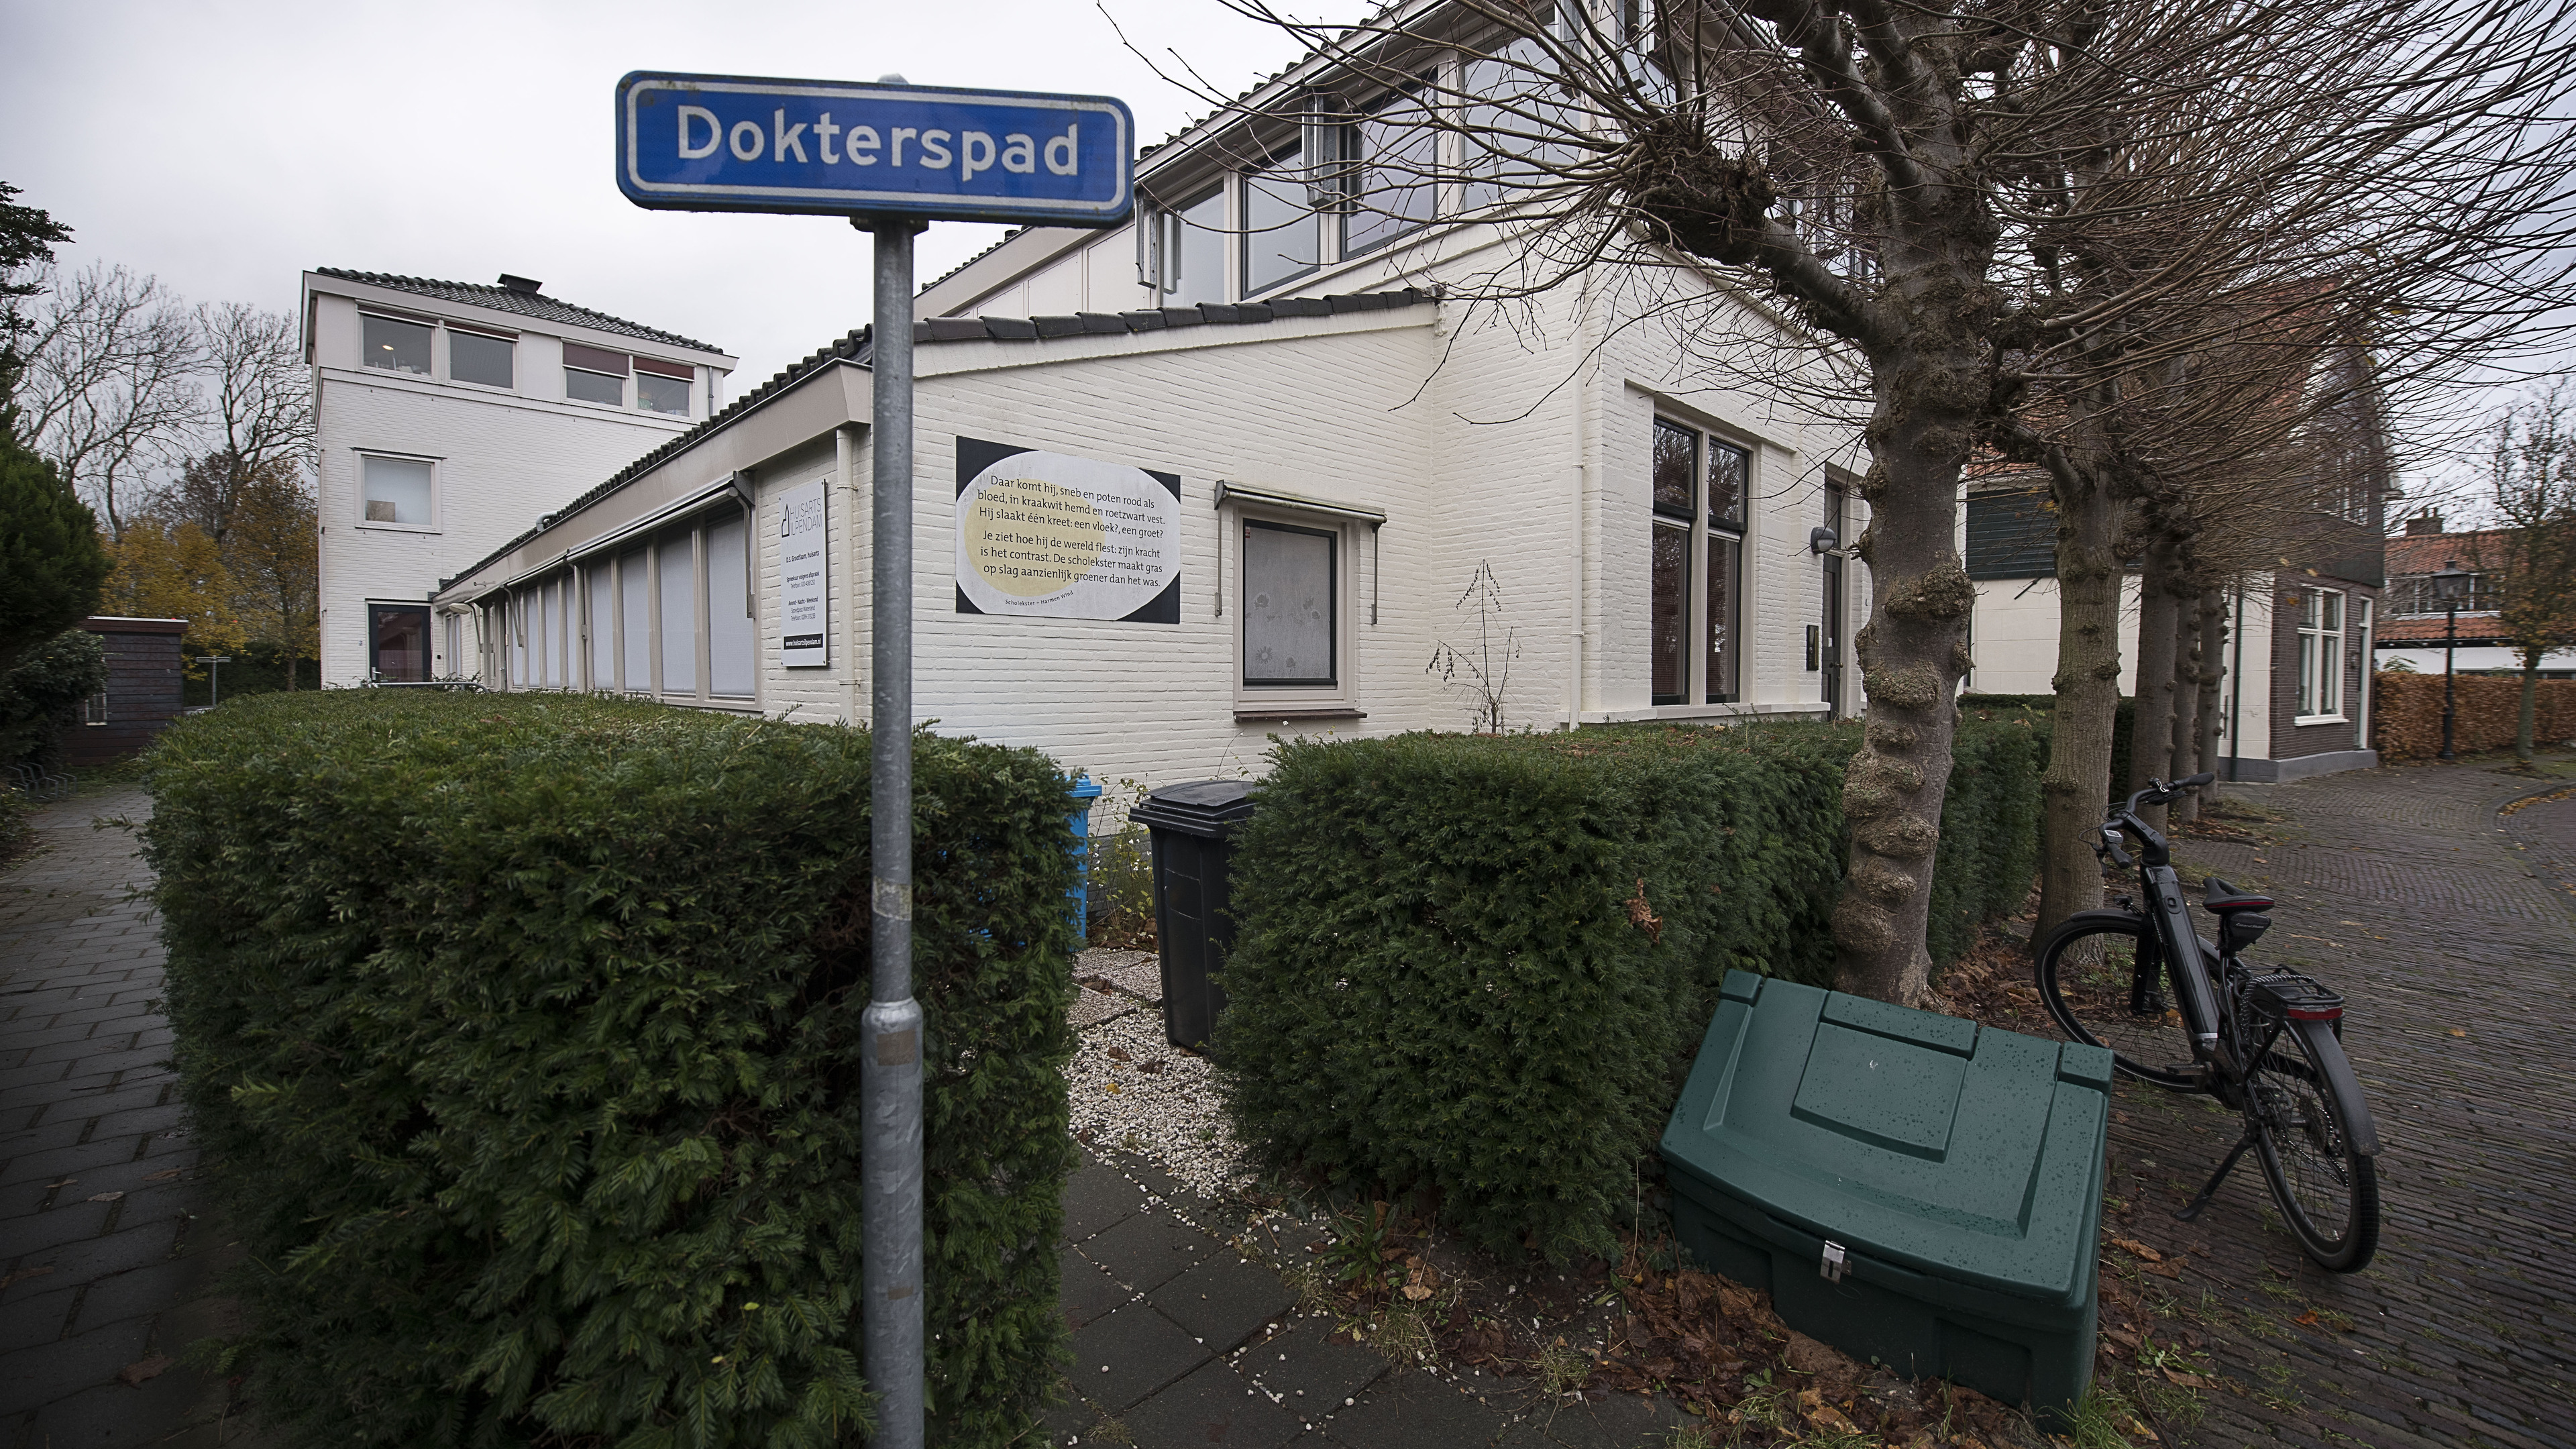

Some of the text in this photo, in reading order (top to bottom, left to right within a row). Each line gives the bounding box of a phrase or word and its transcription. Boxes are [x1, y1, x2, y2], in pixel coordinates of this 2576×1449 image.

[678, 104, 1078, 182] Dokterspad
[991, 475, 1155, 508] Daar komt hij, sneb en poten rood als
[790, 497, 821, 521] HUISARTS
[977, 489, 1165, 525] bloed, in kraakwit hemd en roetzwart vest.
[790, 513, 822, 535] ILPENDAM
[979, 506, 1163, 539] Hij slaakt één kreet: een vloek?, een groet?
[807, 550, 820, 558] huisarts
[983, 530, 1161, 558] Je ziet hoe hij de wereld flest: zijn kracht
[980, 546, 1163, 574] is het contrast. De scholekster maakt gras
[808, 570, 820, 578] afspraak
[983, 564, 1161, 587] op slag aanzienlijk groener dan het was.
[1040, 596, 1061, 604] Harmen
[1061, 590, 1073, 599] Wind
[786, 637, 822, 647] www.huisartsilpendam.nl
